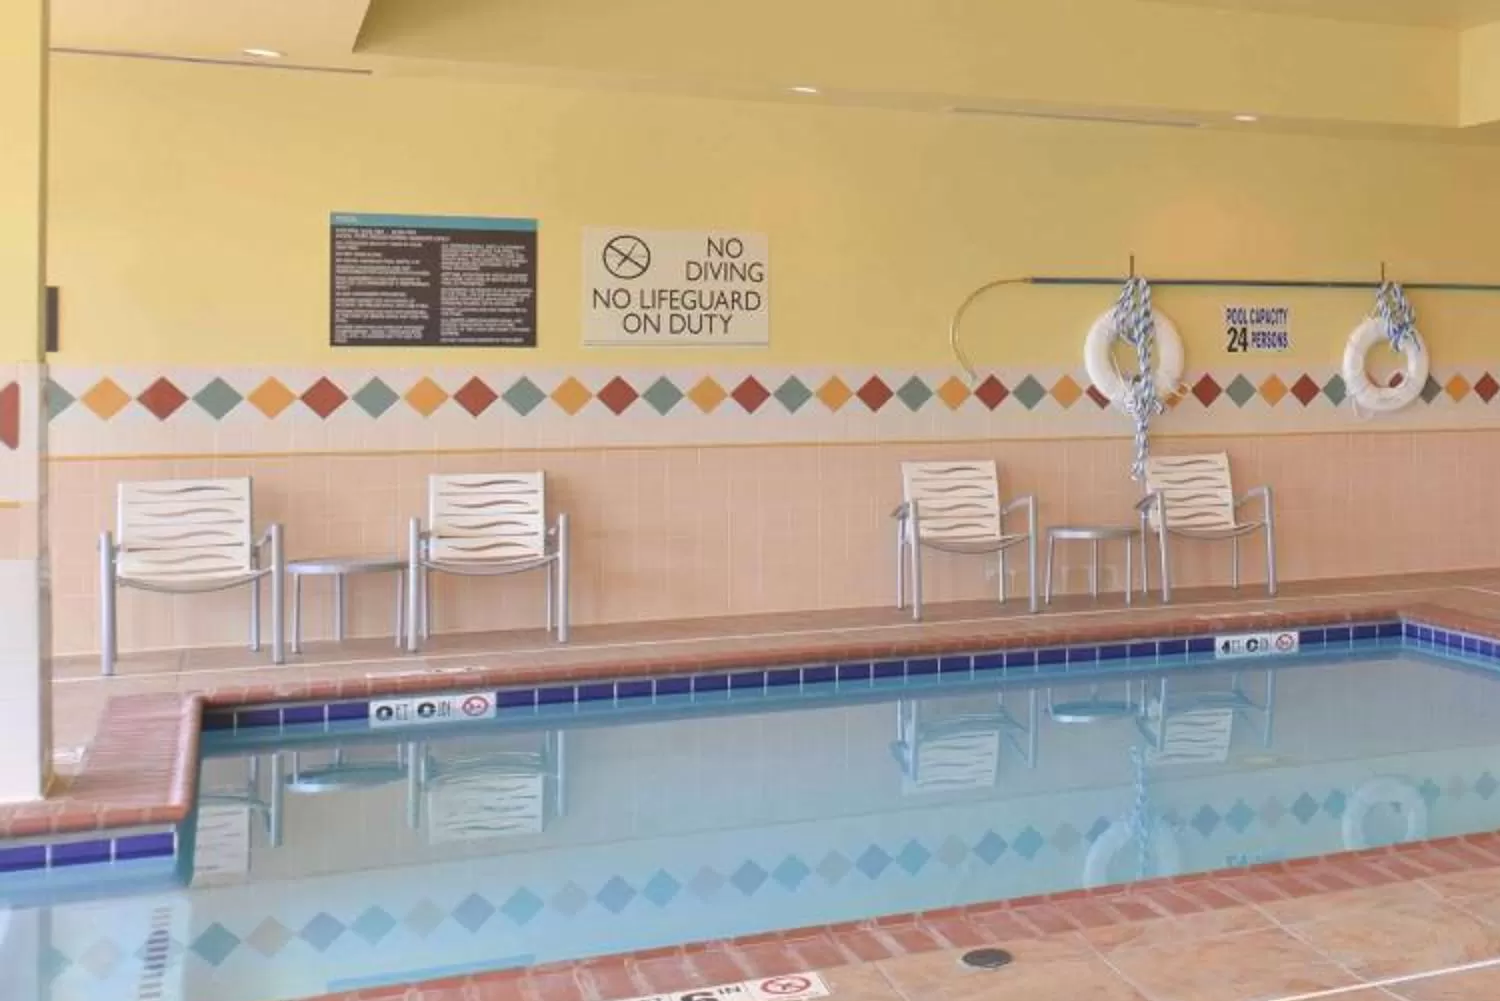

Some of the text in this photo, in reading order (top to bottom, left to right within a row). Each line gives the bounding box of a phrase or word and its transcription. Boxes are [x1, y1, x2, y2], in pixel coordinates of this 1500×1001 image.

[707, 237, 743, 258] NO
[686, 261, 764, 282] DIVING
[593, 287, 761, 311] NO LIFEGUARD
[623, 313, 732, 334] ON DUTY
[1227, 308, 1288, 325] POOL CAPACITY
[1227, 327, 1288, 352] 24 PERSONS
[717, 985, 742, 996] IN
